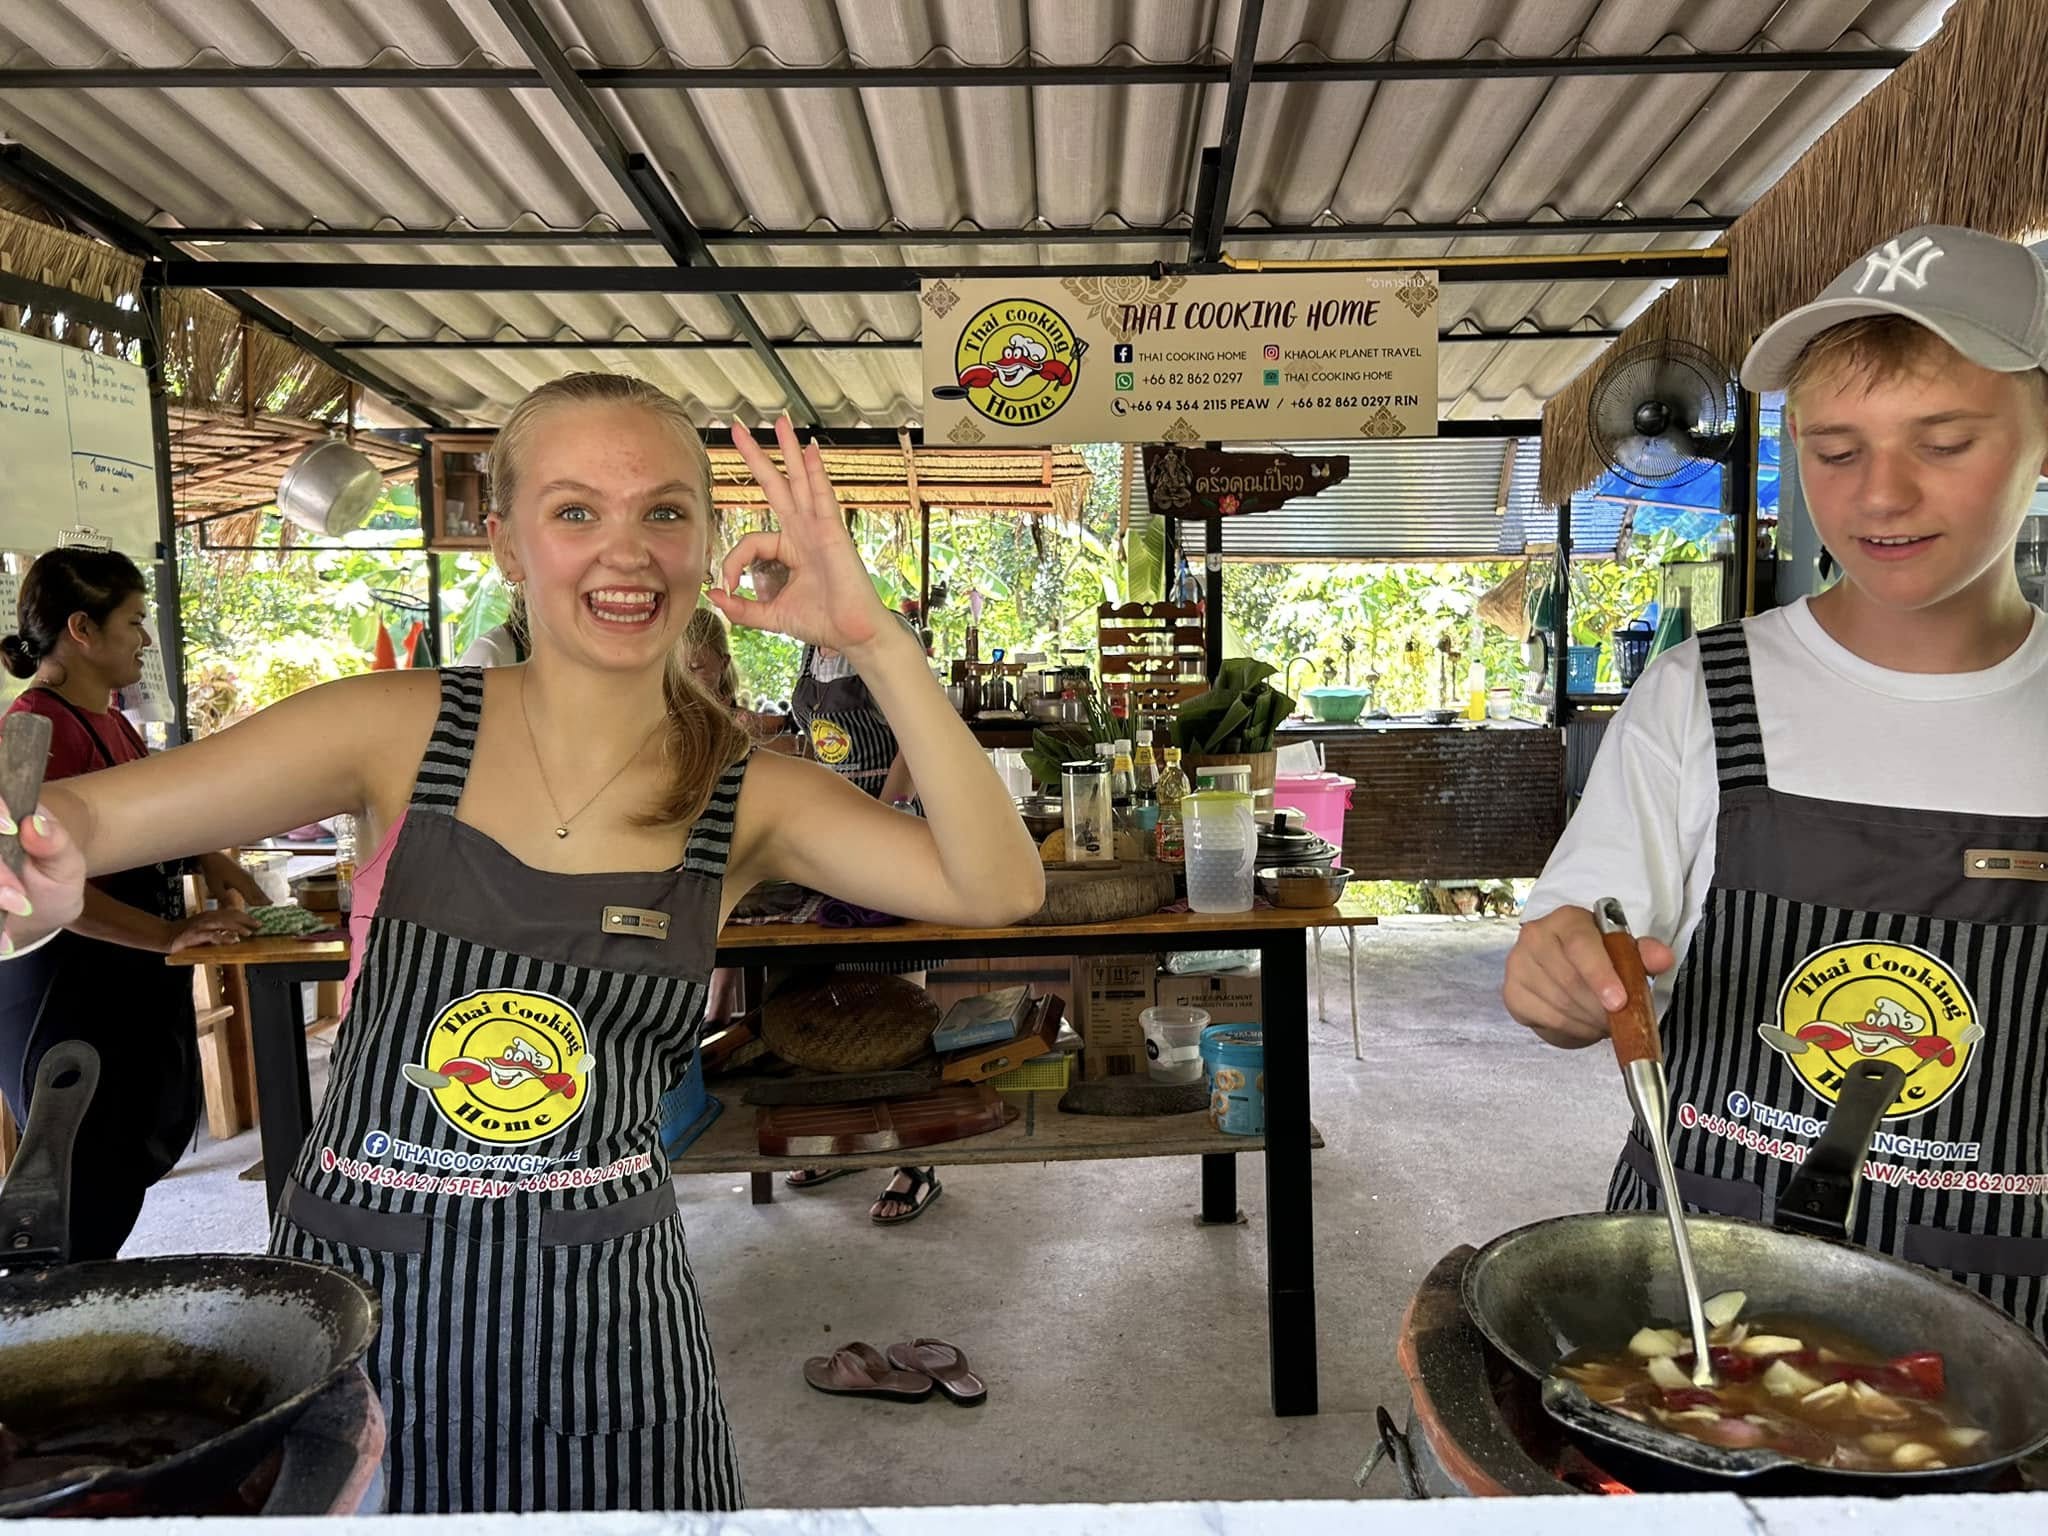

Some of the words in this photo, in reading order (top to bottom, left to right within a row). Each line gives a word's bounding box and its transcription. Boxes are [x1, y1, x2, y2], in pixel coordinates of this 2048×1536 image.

[965, 313, 999, 352] Thai
[1118, 302, 1178, 335] THAI
[1184, 300, 1298, 331] COOKING
[1306, 300, 1381, 331] HOME
[1138, 352, 1163, 362] THAI
[1166, 351, 1215, 362] COOKING
[1217, 351, 1247, 361] HOME
[1284, 349, 1337, 360] KHAOLAK
[1339, 348, 1379, 359] PLANET
[1379, 347, 1421, 358] TRAVEL
[1142, 374, 1165, 385] +66
[1169, 373, 1184, 385] 82
[1187, 373, 1210, 385] 862
[1213, 372, 1243, 385] 0297
[1284, 372, 1309, 383] THAI
[1312, 371, 1361, 382] COOKING
[1363, 370, 1392, 381] HOME
[985, 394, 1055, 421] Home
[1130, 401, 1152, 412] +66
[1156, 400, 1171, 411] 94
[1176, 400, 1199, 411] 364
[1203, 400, 1227, 410] 2115
[1230, 398, 1269, 410] PEAW
[1291, 398, 1313, 409] +66
[1317, 398, 1331, 408] 82
[1335, 397, 1358, 408] 862
[1361, 396, 1391, 407] 0297
[1394, 395, 1418, 406] RIN
[1794, 958, 1851, 998] Thai
[1862, 952, 1967, 1022] Cooking
[440, 1001, 492, 1036] Thai
[502, 1001, 582, 1057] Cooking
[1814, 1067, 1926, 1104] He
[454, 1100, 552, 1133] Home
